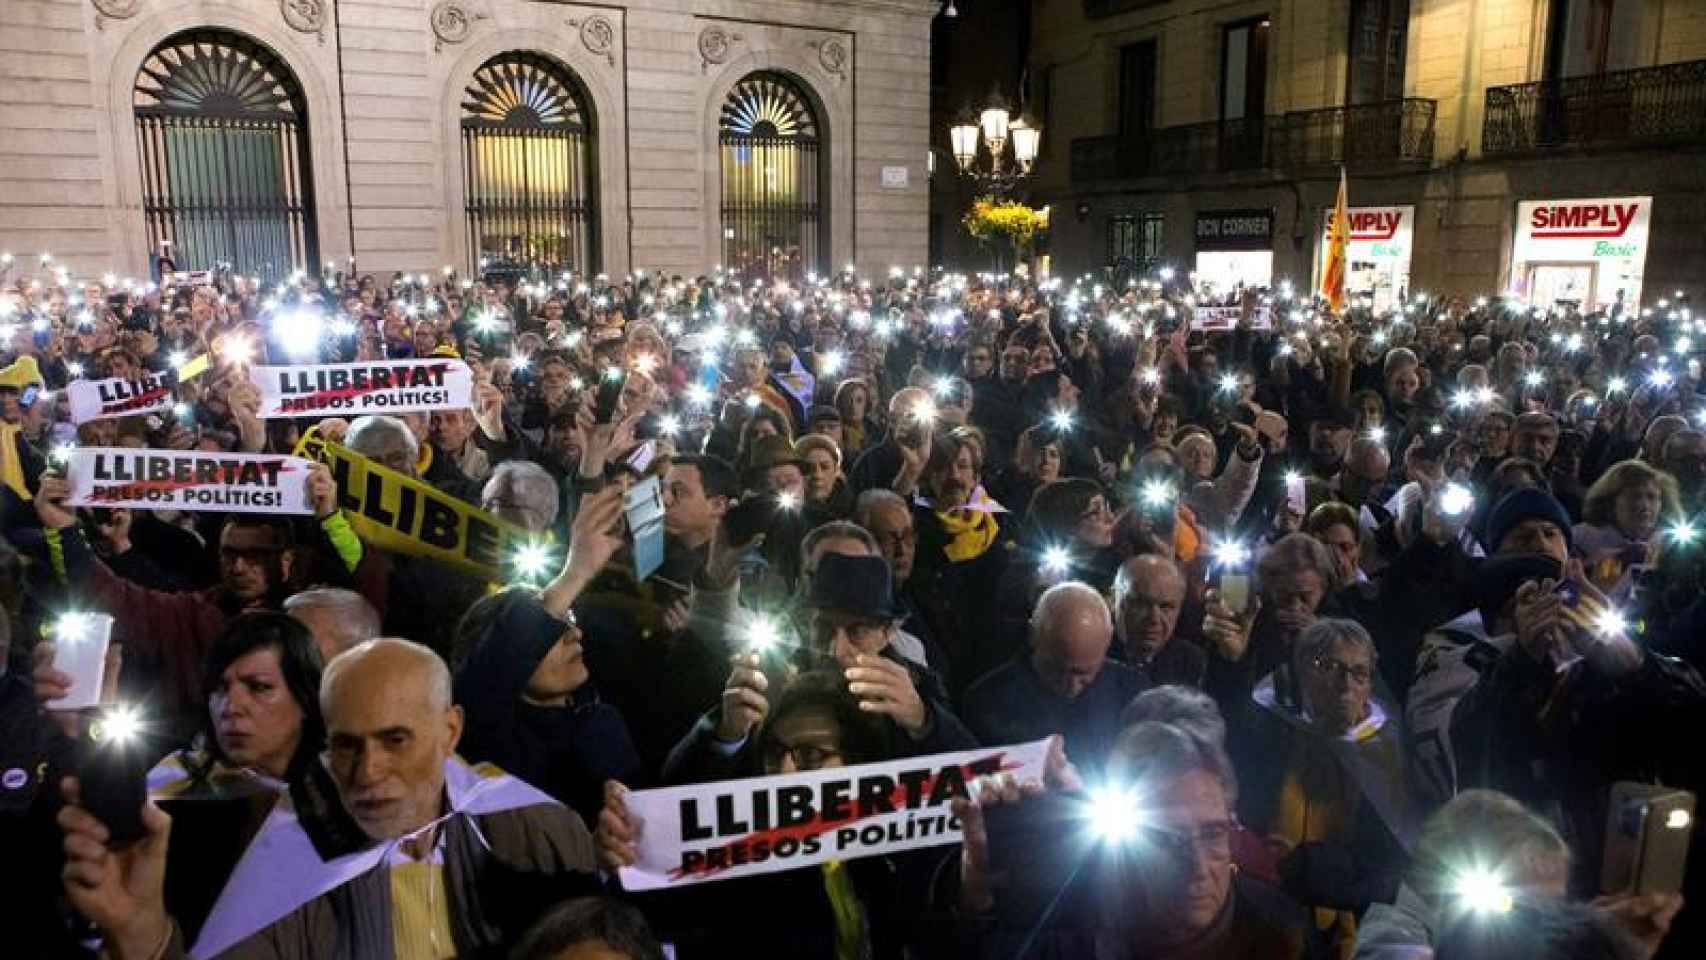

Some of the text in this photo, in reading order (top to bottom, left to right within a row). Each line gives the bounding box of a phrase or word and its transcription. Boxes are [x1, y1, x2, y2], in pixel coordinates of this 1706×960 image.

[279, 363, 449, 393] LLIBERTAT
[363, 390, 449, 408] POLÍTICS!
[94, 454, 284, 487] LLIBERTAT
[183, 487, 282, 506] POLÍTICS!
[681, 836, 821, 871] PRESOS
